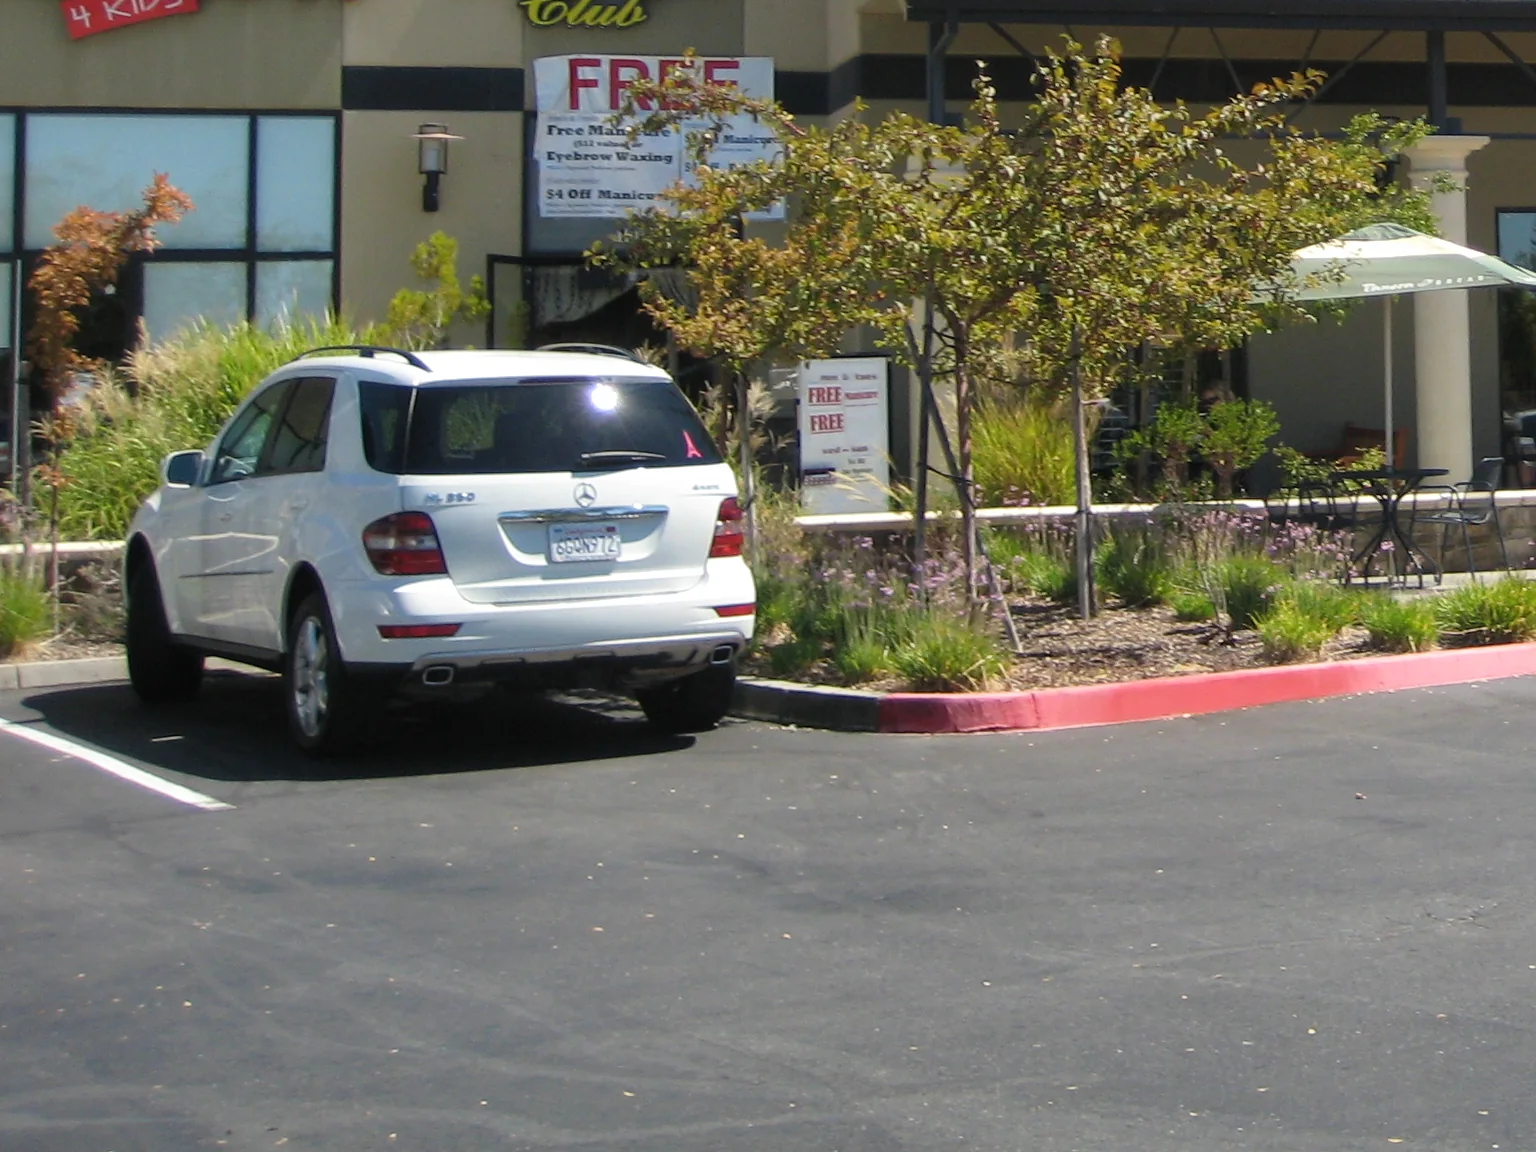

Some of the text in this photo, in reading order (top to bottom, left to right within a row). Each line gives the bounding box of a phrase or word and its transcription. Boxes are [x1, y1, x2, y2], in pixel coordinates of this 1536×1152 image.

[71, 5, 91, 28] 4
[546, 125, 671, 137] Free Manure
[546, 151, 673, 165] Eyebrow Waxing
[567, 188, 592, 200] Off
[808, 386, 842, 404] FREE
[810, 414, 844, 432] FREE
